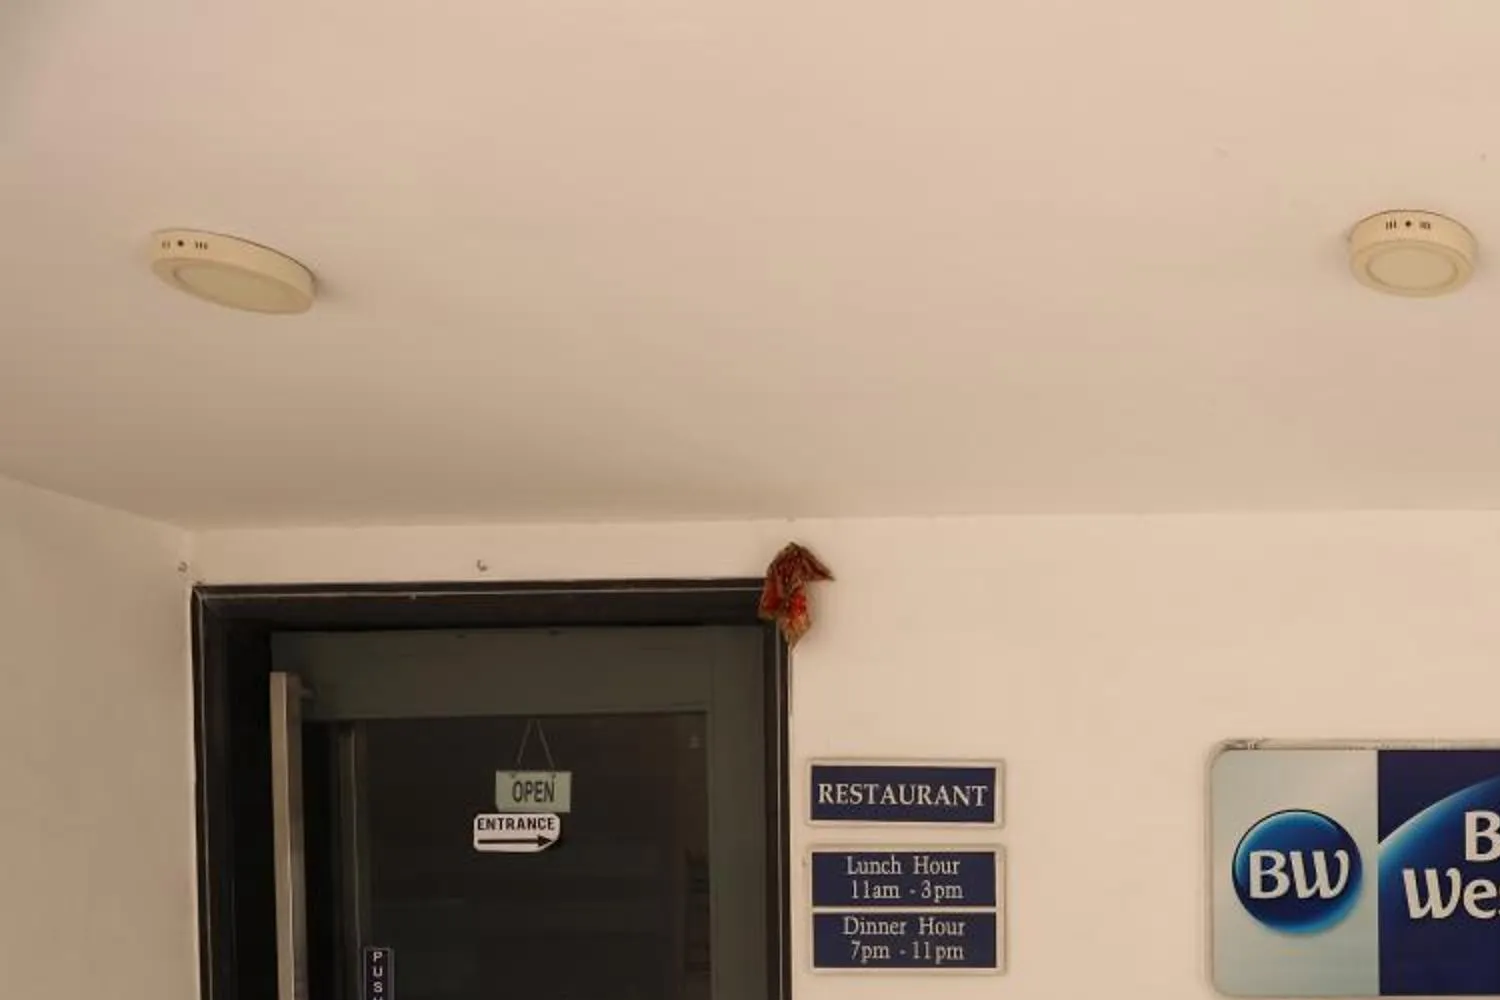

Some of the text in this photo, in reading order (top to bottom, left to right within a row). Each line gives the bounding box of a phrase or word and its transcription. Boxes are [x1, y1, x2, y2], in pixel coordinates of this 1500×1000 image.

[511, 780, 555, 803] OPEN
[817, 783, 989, 807] RESTAURANT
[477, 817, 556, 831] ENTRANCE
[846, 854, 961, 876] Lunch Hour
[1248, 849, 1350, 899] BW
[851, 880, 901, 900] 11am
[921, 880, 964, 903] 3pm
[843, 916, 966, 937] Dinner Hour
[850, 940, 891, 965] 7pm
[911, 941, 965, 966] 11pm
